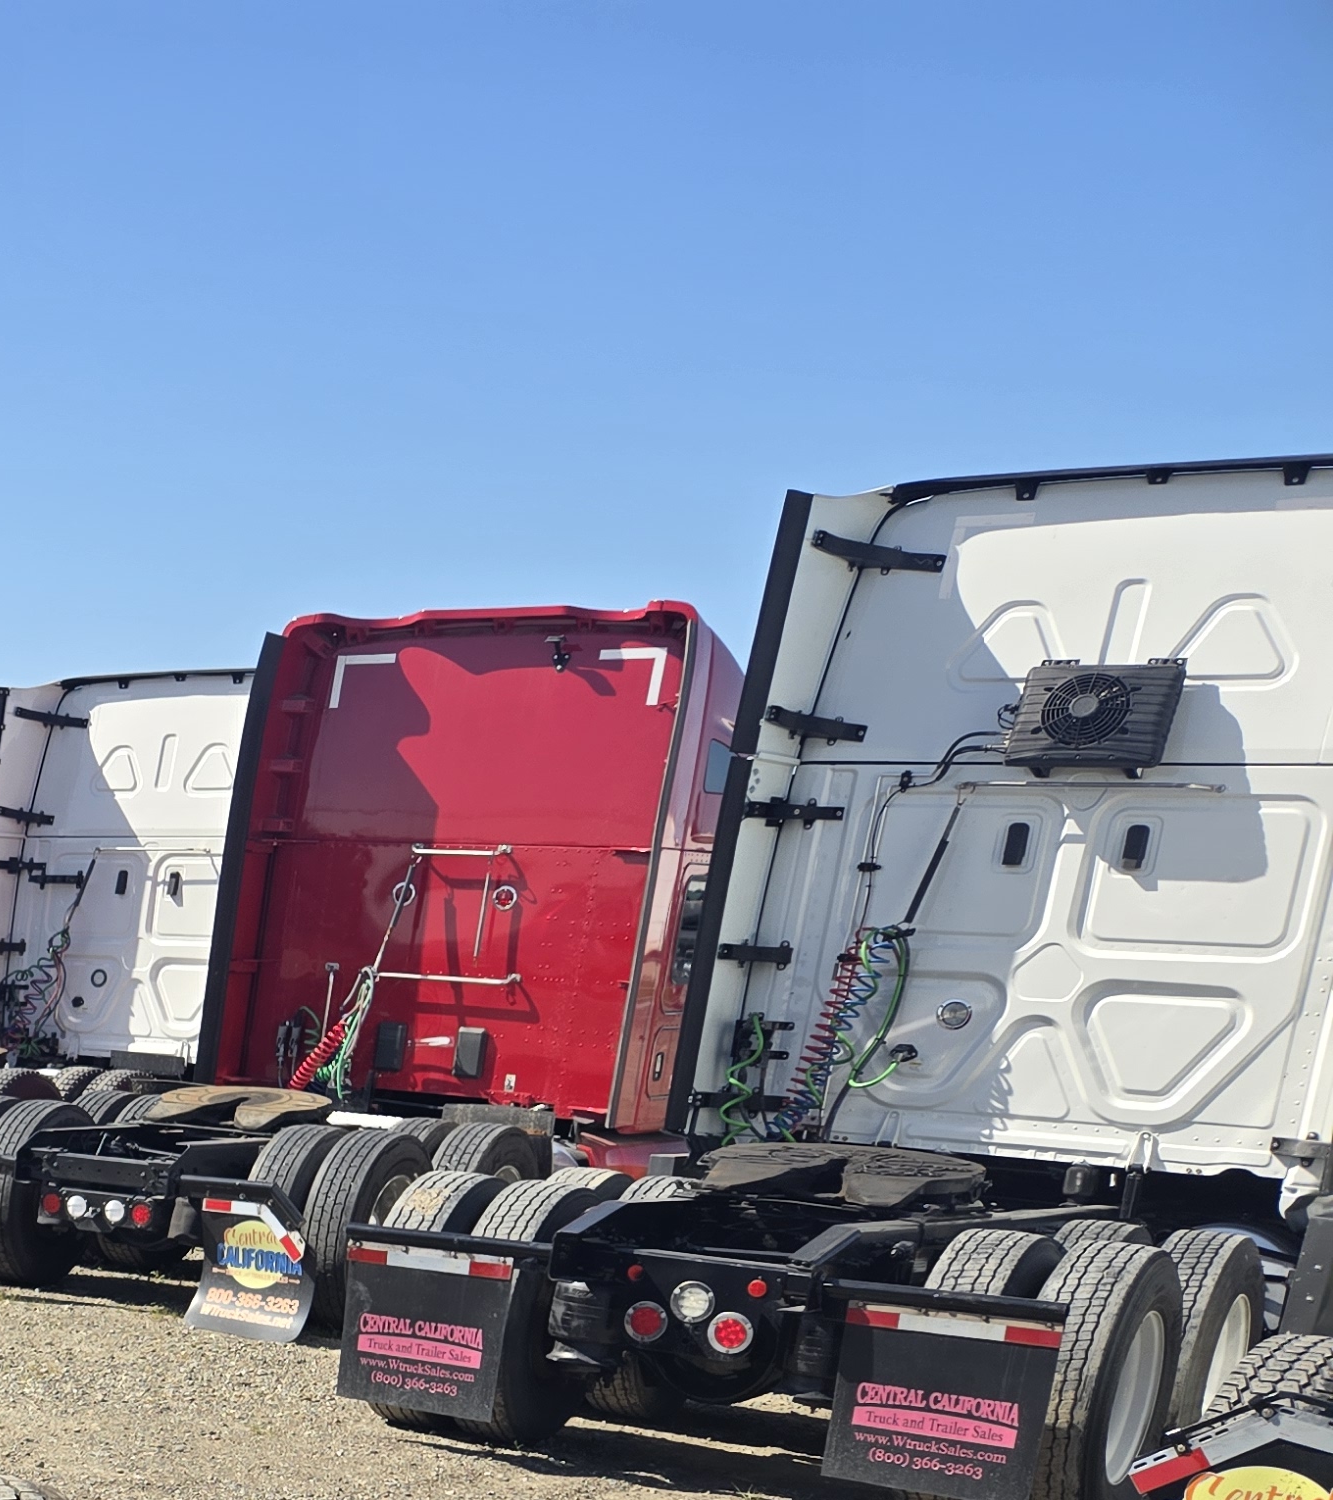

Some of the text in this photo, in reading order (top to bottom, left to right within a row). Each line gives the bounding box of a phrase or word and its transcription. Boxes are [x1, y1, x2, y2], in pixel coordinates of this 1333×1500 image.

[224, 1227, 278, 1246] Centra
[206, 1287, 299, 1315] 800-366-3263
[360, 1313, 483, 1350] CENTRAL CALIFORNIA
[367, 1338, 472, 1364] Truck and Trailer Sales
[360, 1356, 474, 1382] www.WtruckSales.com
[371, 1370, 457, 1396] (800) 366-3263
[856, 1382, 1019, 1427] CENTRAL CALIFORNIA
[866, 1410, 1003, 1443] Truck and Trailer Sales
[854, 1431, 1007, 1464] www.WtruckSales.com
[869, 1447, 983, 1480] (800) 366-3263
